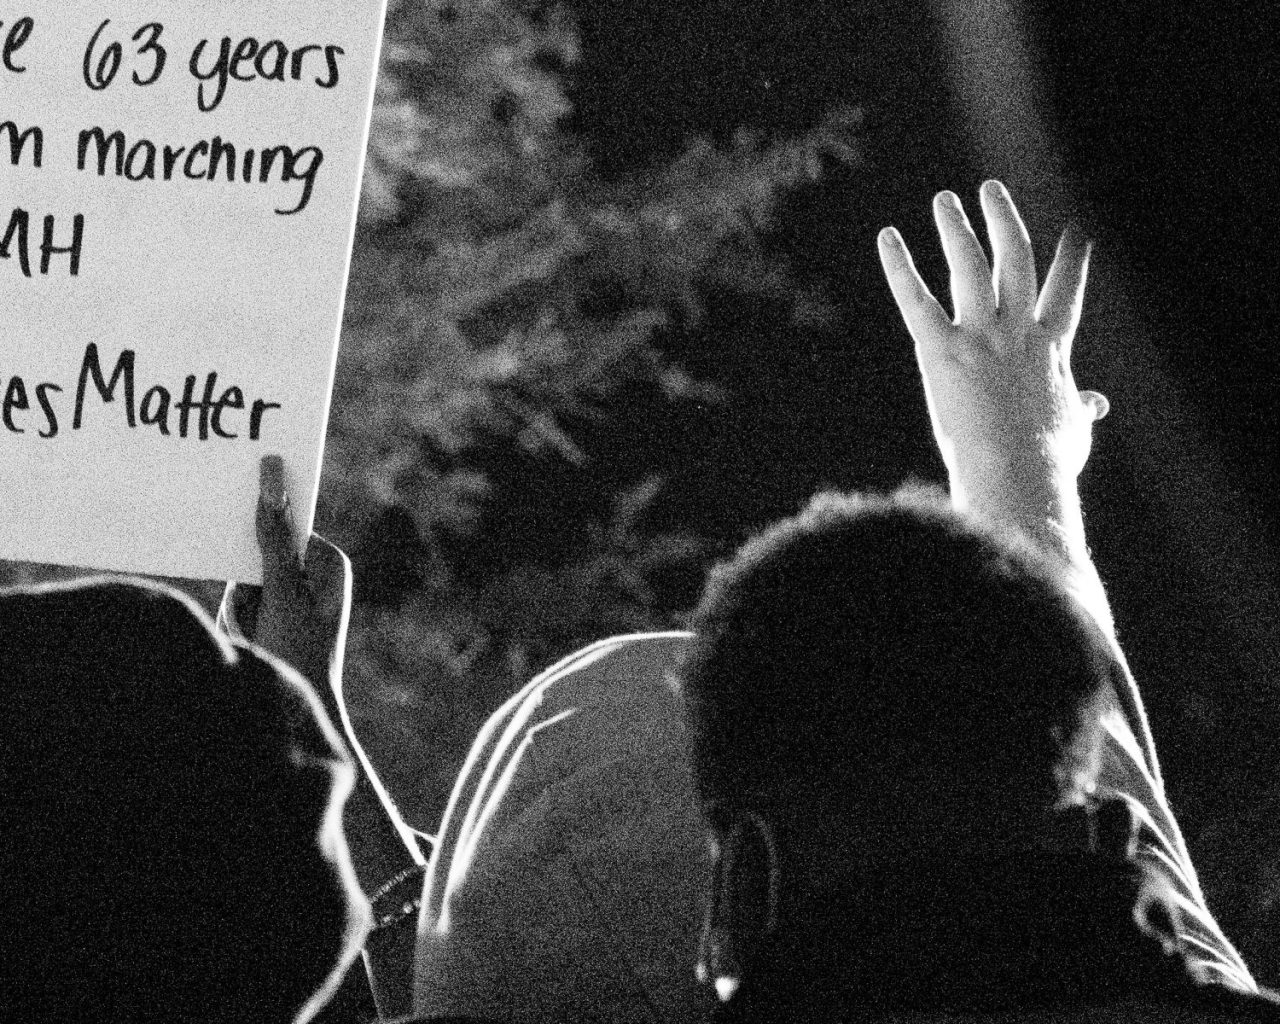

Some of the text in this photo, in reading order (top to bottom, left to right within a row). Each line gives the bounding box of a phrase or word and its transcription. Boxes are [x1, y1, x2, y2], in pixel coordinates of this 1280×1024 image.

[82, 18, 168, 92] 63
[188, 35, 346, 113] years
[76, 125, 325, 216] marching
